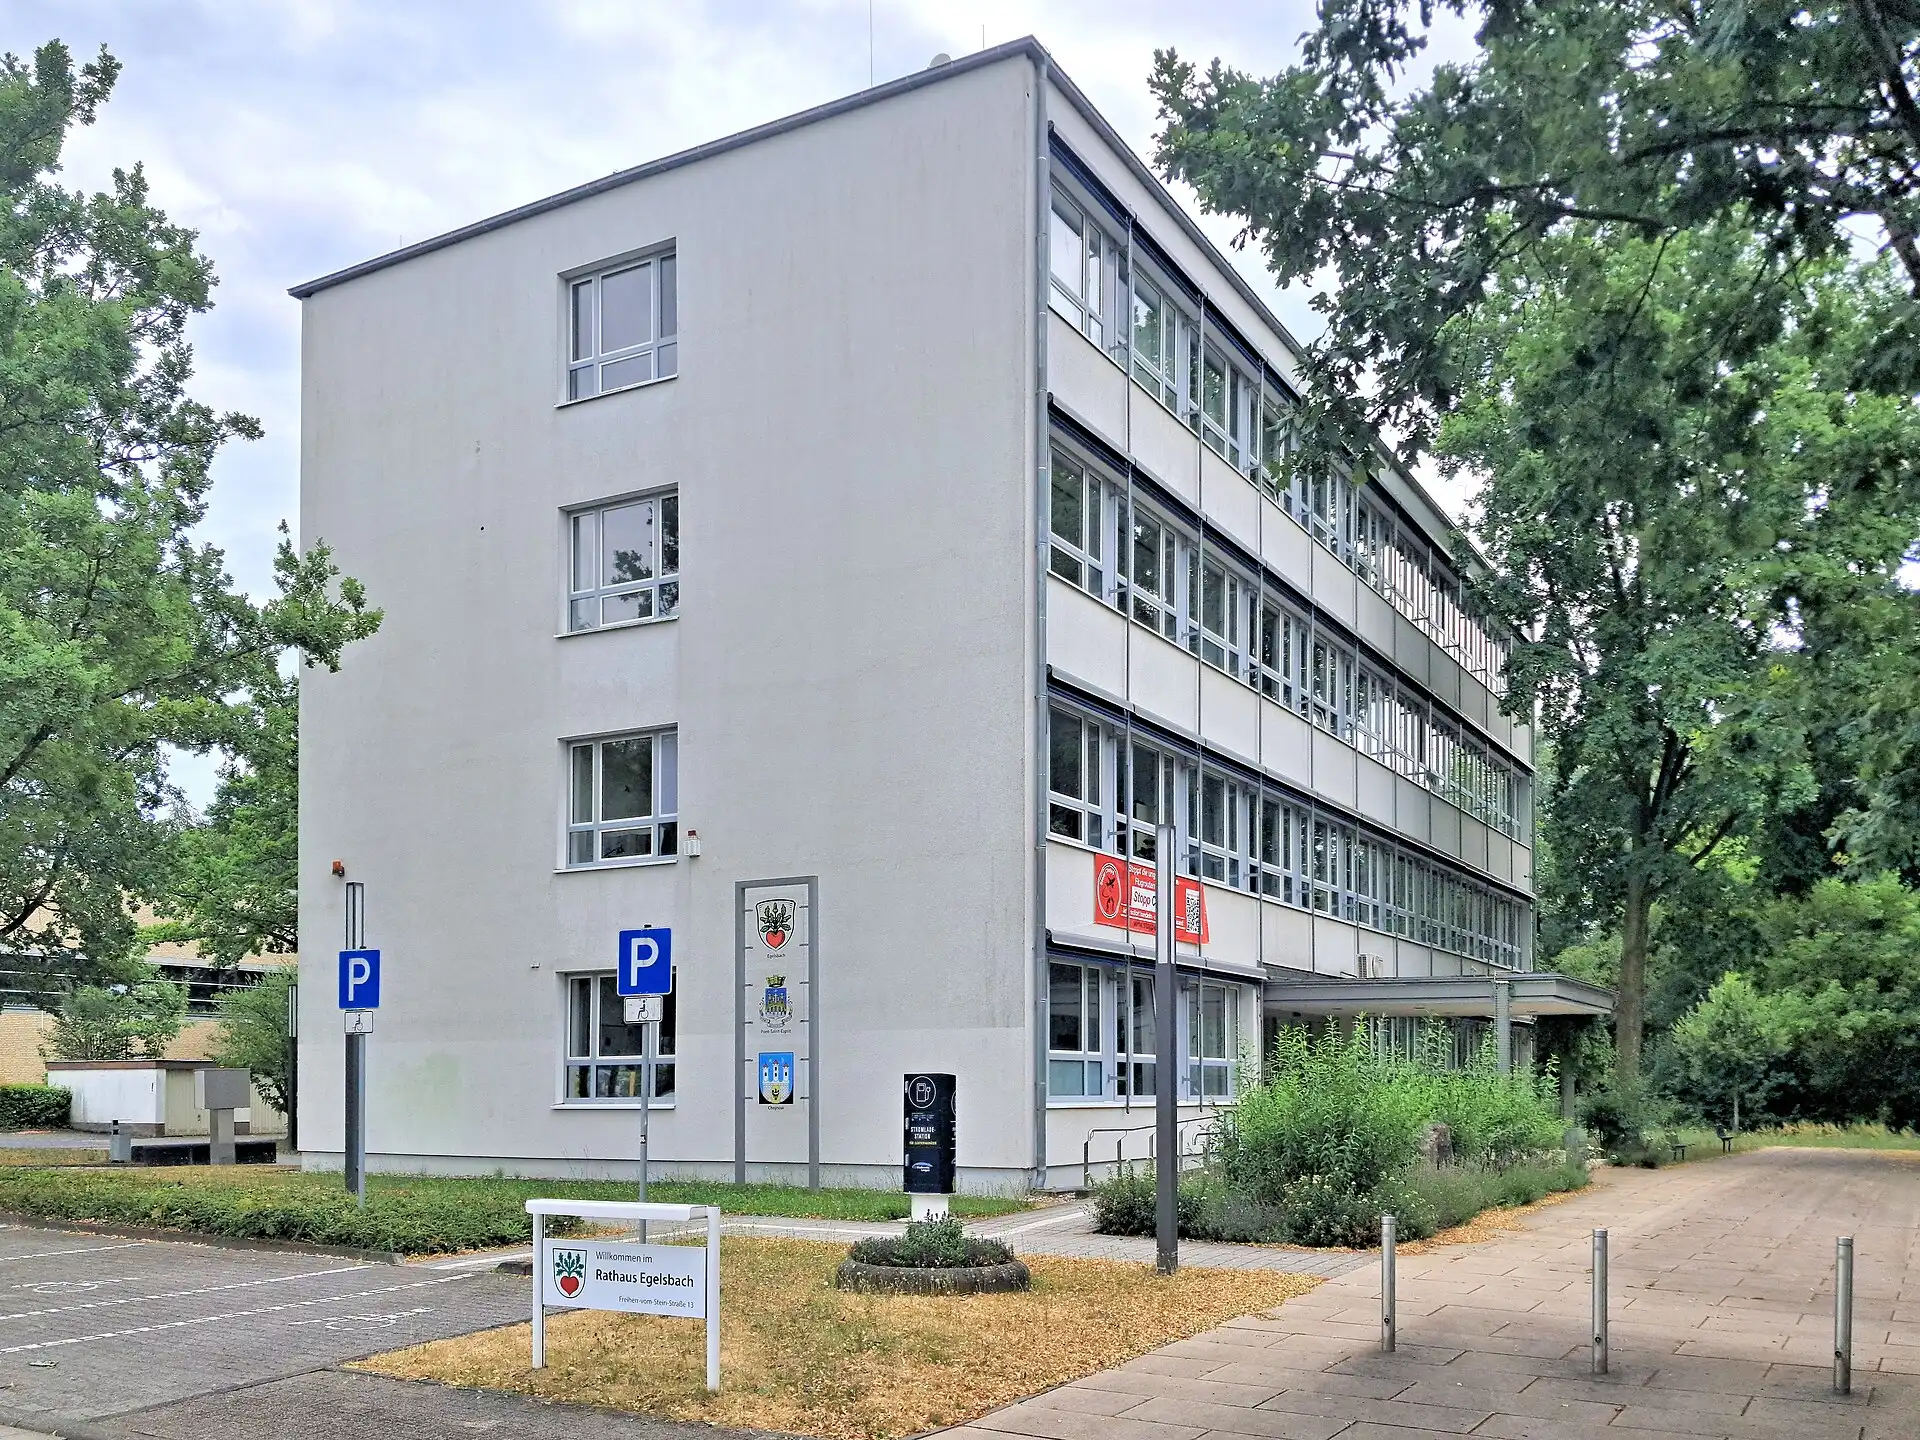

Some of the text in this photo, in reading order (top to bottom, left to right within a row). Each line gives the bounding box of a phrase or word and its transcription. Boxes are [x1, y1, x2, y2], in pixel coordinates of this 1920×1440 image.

[1133, 891, 1151, 907] Stopp
[630, 937, 660, 987] P
[348, 957, 371, 1001] P
[595, 1251, 653, 1263] Willkommen im
[595, 1268, 694, 1288] Rathaus Egelsbach
[687, 1301, 695, 1309] 13
